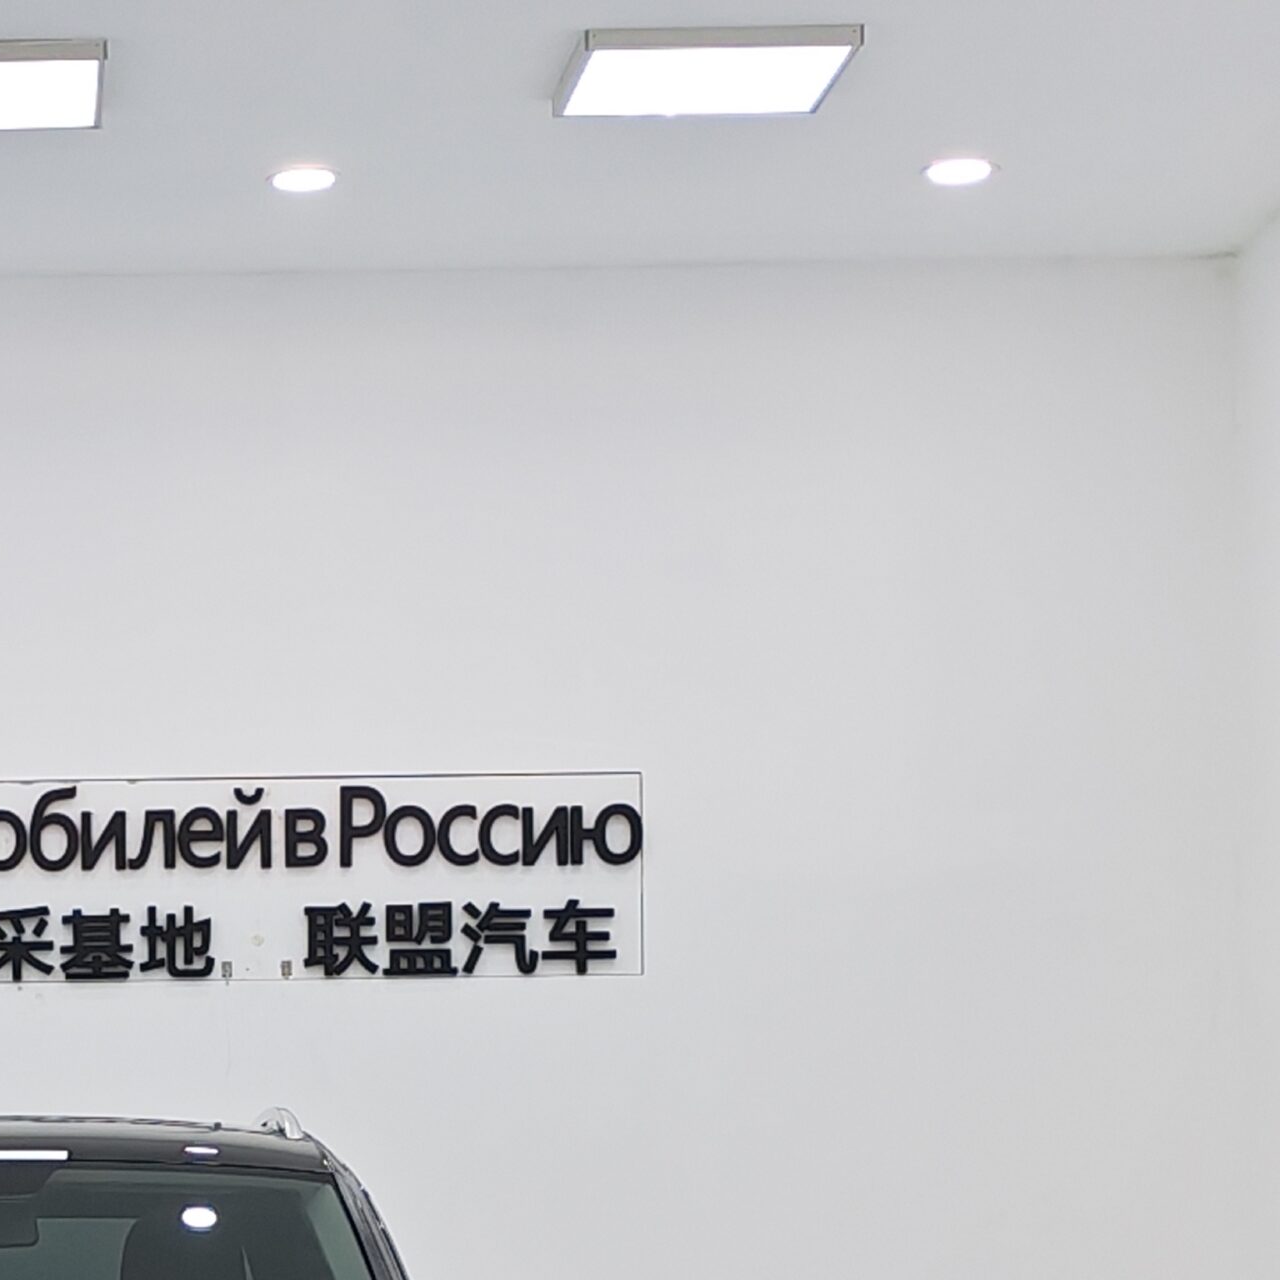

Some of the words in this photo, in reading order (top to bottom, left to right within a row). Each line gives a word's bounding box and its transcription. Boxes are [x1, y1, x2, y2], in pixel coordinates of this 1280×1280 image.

[284, 808, 329, 869] в
[339, 785, 644, 869] Россию
[303, 899, 617, 977] 联盟汽车
